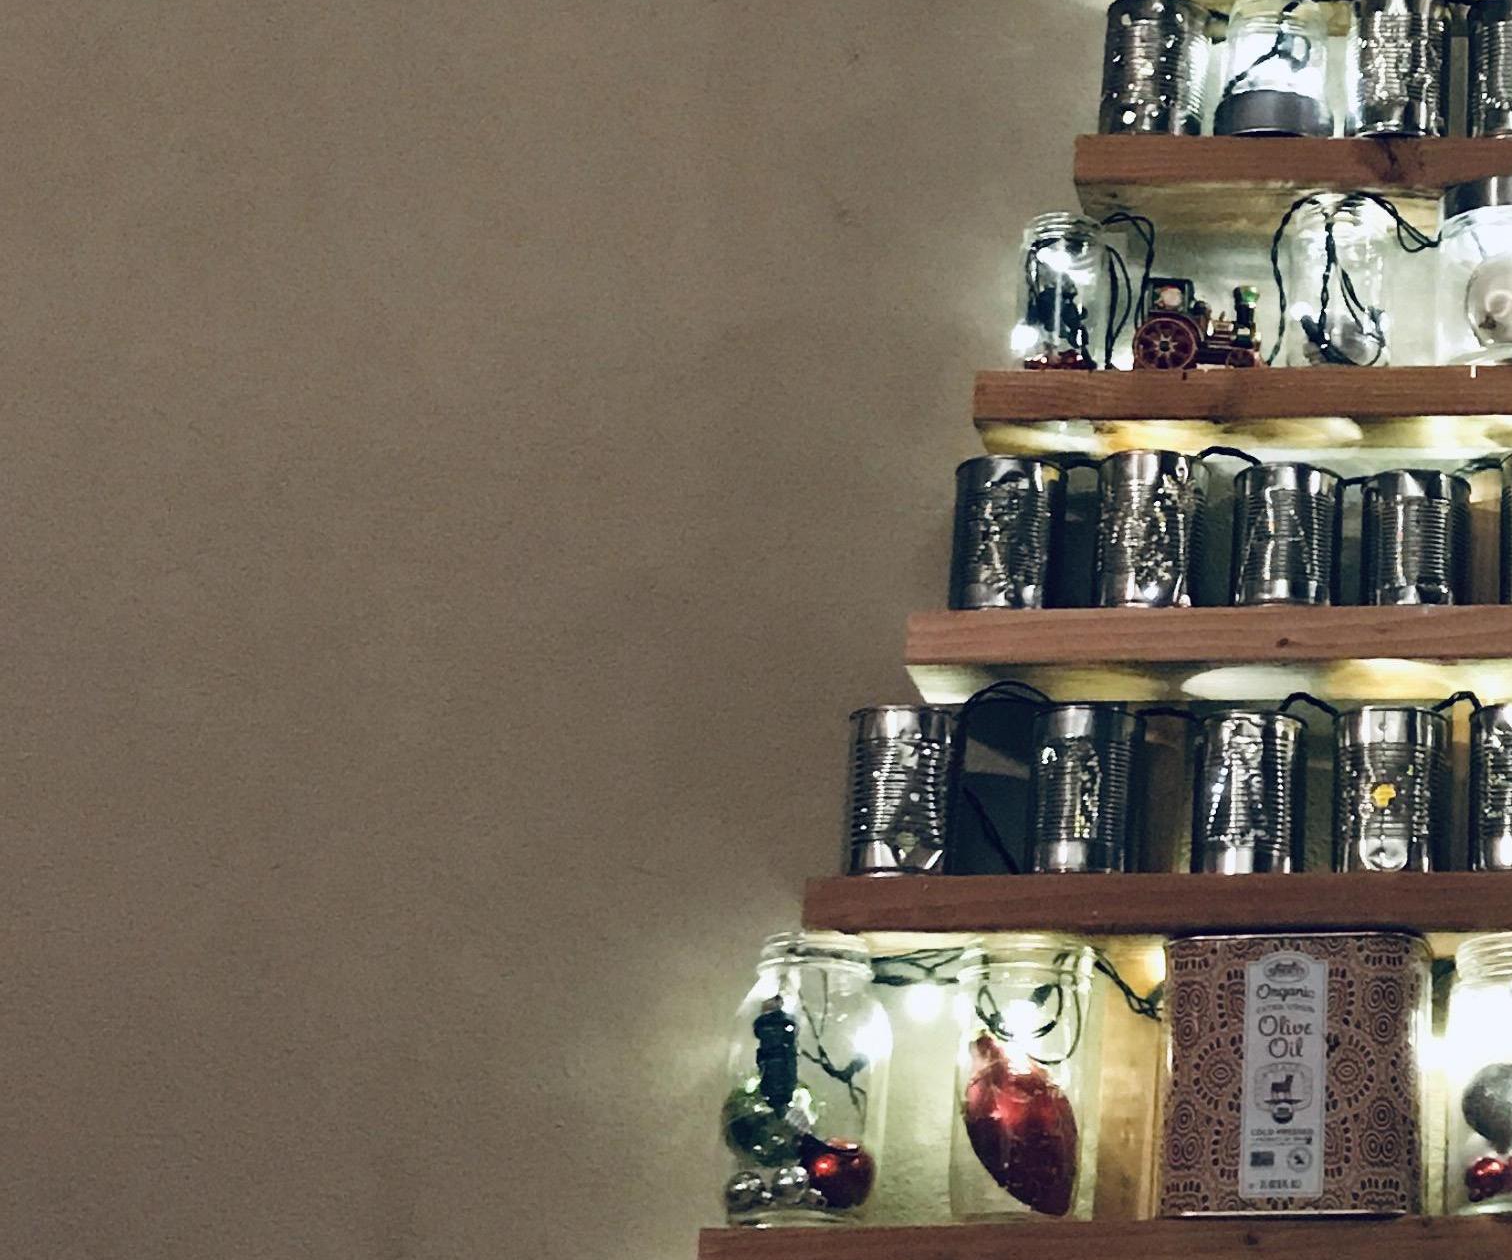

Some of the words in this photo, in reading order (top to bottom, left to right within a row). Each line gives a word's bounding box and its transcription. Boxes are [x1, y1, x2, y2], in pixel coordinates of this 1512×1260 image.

[1256, 983, 1316, 1002] Organic
[1258, 1014, 1313, 1037] Olive
[1268, 1036, 1304, 1059] Oil
